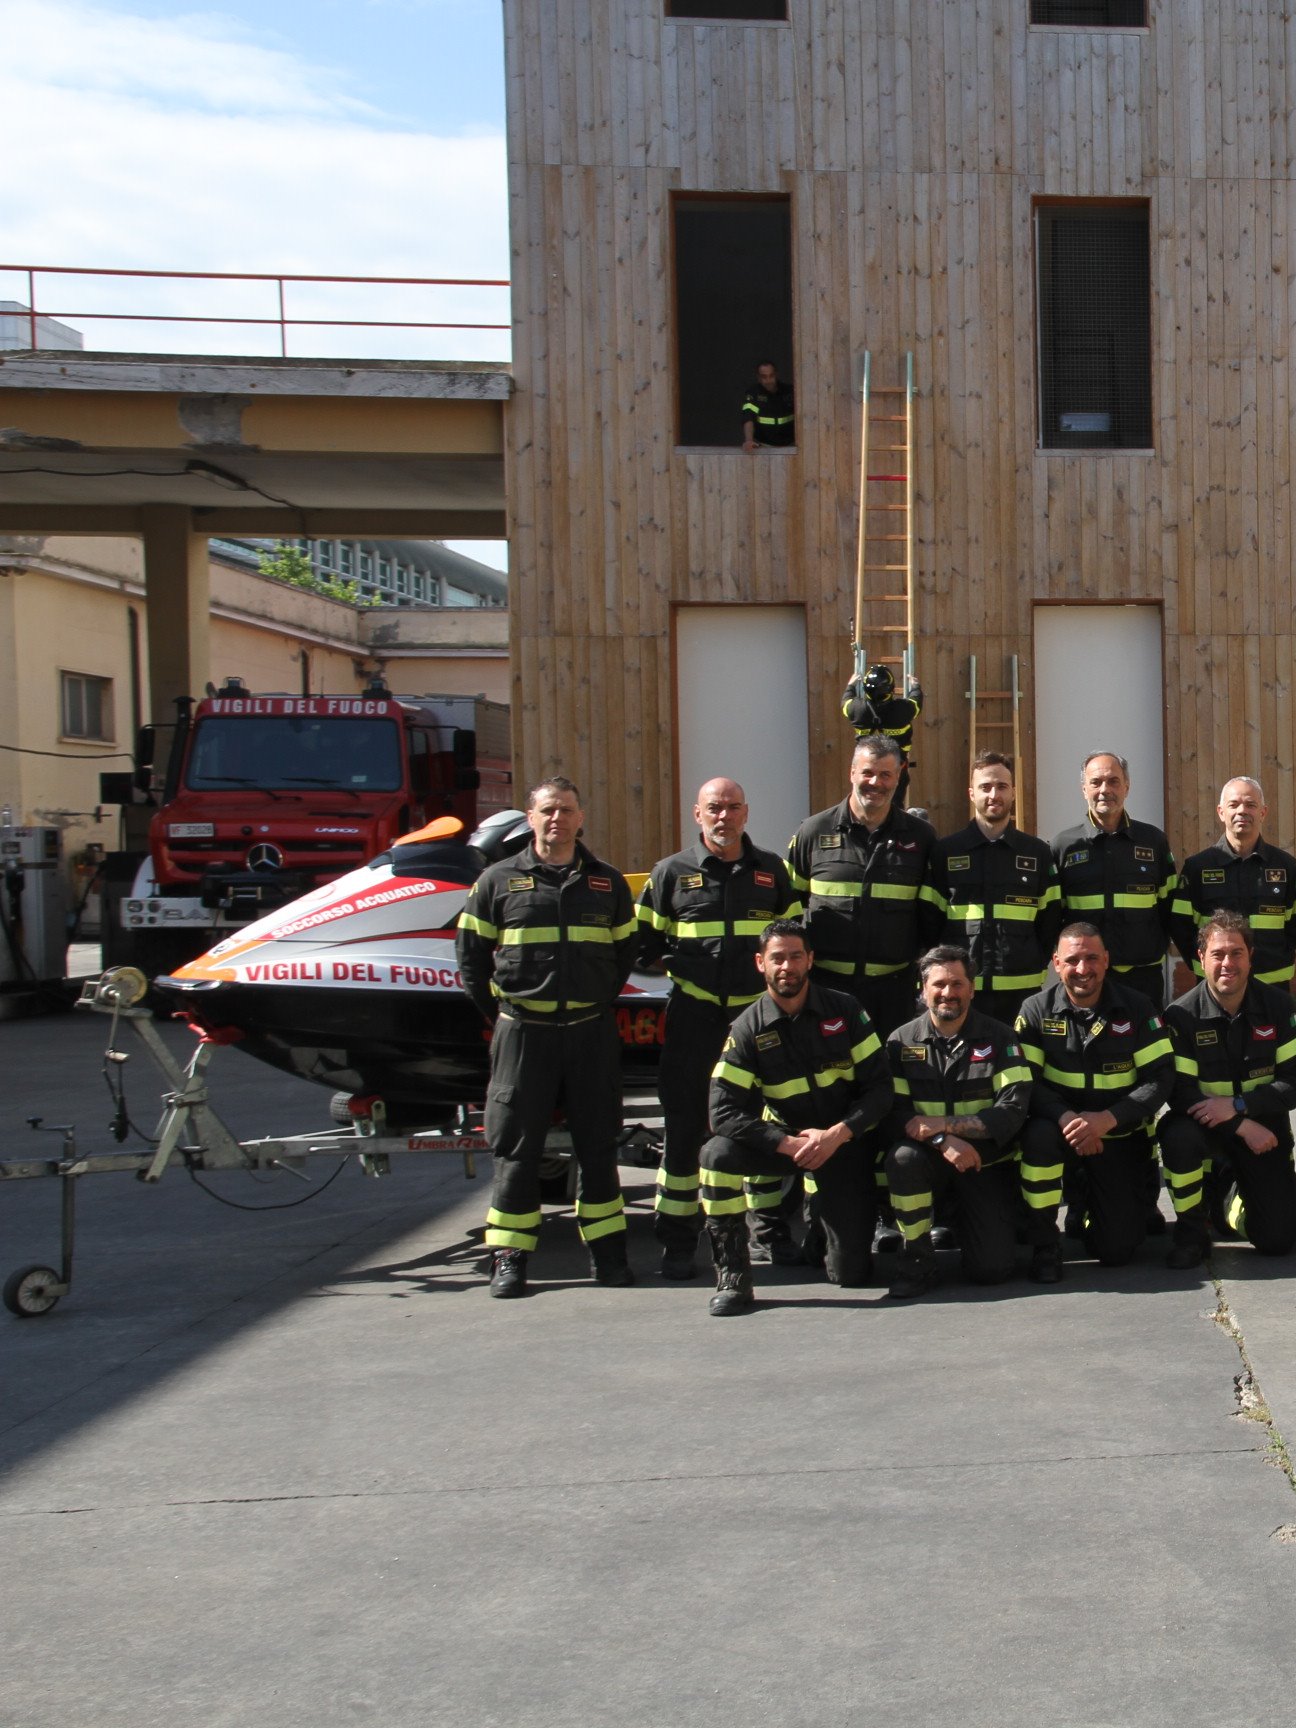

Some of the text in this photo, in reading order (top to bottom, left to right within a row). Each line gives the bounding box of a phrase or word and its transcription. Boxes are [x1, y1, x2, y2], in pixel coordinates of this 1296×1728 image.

[212, 699, 388, 715] VIGILI DEL FUOCO
[270, 881, 437, 939] SOCCORSO ACQUATICO
[245, 962, 322, 981] VIGILI
[333, 963, 382, 983] DEL
